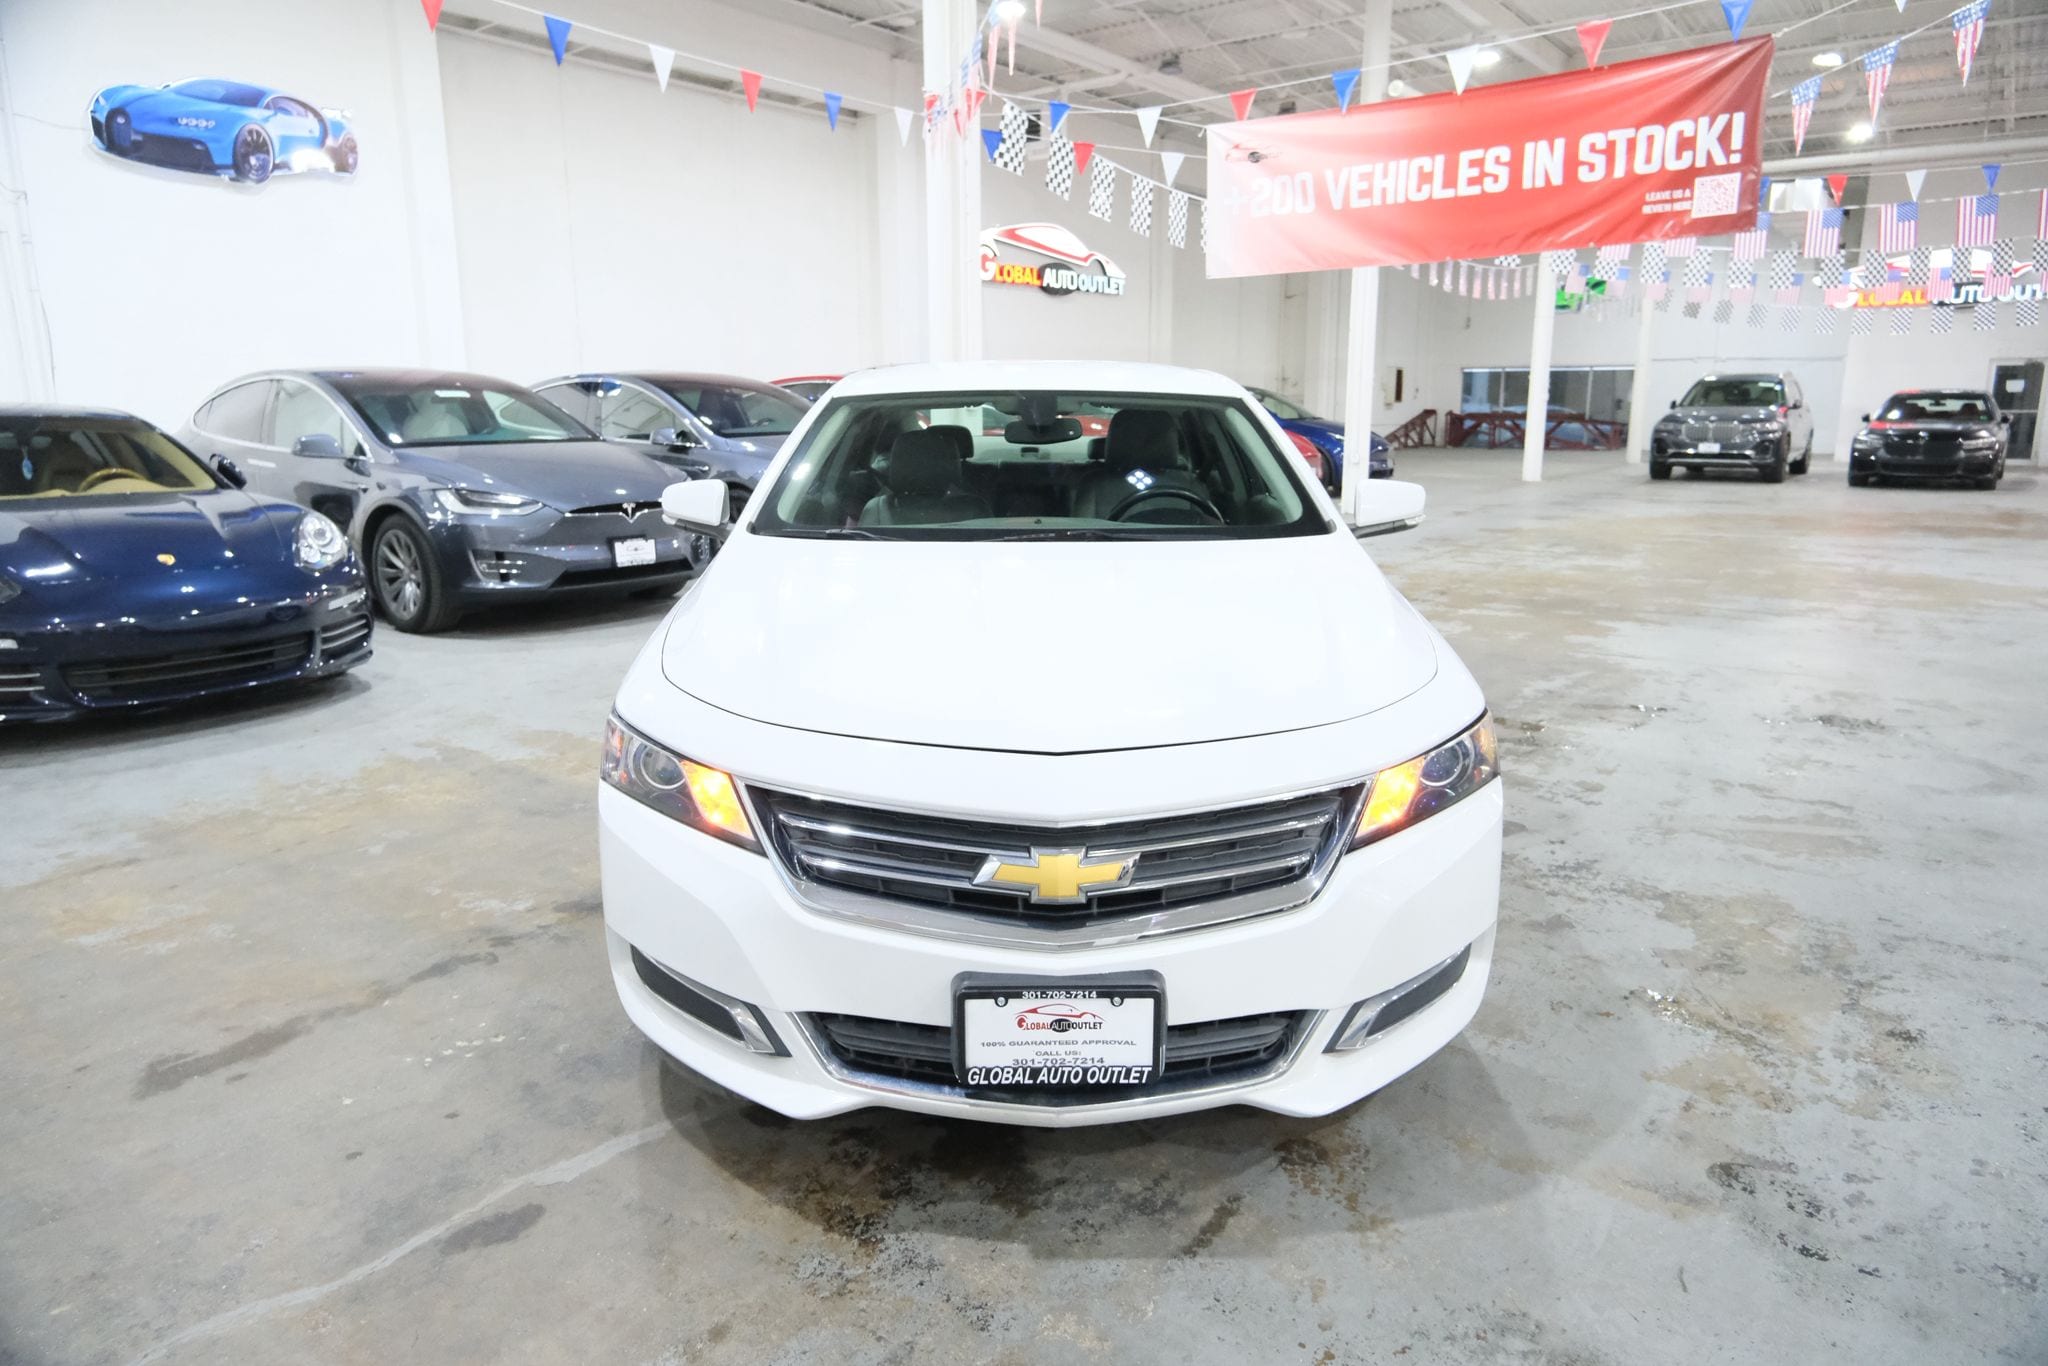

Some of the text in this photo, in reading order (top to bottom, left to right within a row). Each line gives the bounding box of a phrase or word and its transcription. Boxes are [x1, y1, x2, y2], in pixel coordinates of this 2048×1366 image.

[1324, 145, 1511, 211] VEHICLES
[1521, 137, 1566, 190] IN
[1577, 111, 1746, 183] STOCK!
[1645, 190, 1672, 202] LEAVE
[1042, 267, 1078, 290] AUTO
[1078, 274, 1126, 296] OUTLET
[1022, 991, 1098, 1000] 301-702-7214
[1008, 1039, 1078, 1047] GUARANTEED
[1012, 1057, 1105, 1066] 301-702-7214
[967, 1066, 1151, 1085] GLOBAL AUTO OUTLET
